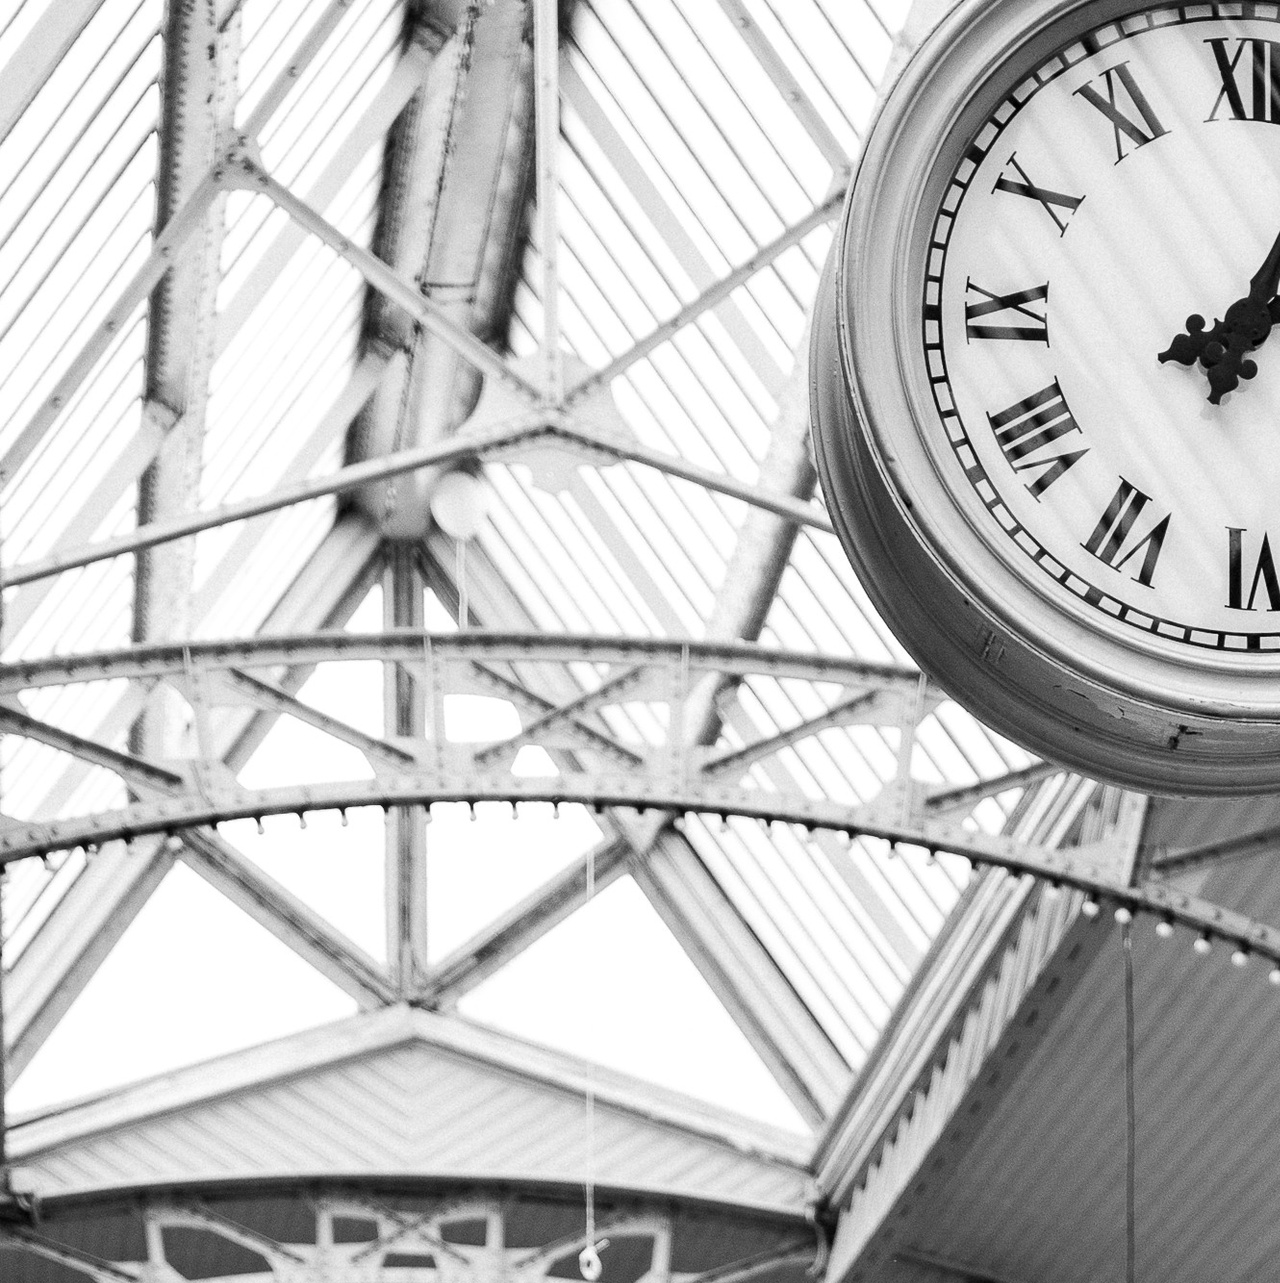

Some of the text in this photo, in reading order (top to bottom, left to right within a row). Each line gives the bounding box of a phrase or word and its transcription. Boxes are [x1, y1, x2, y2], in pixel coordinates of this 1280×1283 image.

[1072, 61, 1171, 165] XI
[991, 151, 1086, 237] X
[965, 276, 1050, 348] IX
[986, 376, 1090, 502] VIII
[1080, 476, 1172, 589] VII
